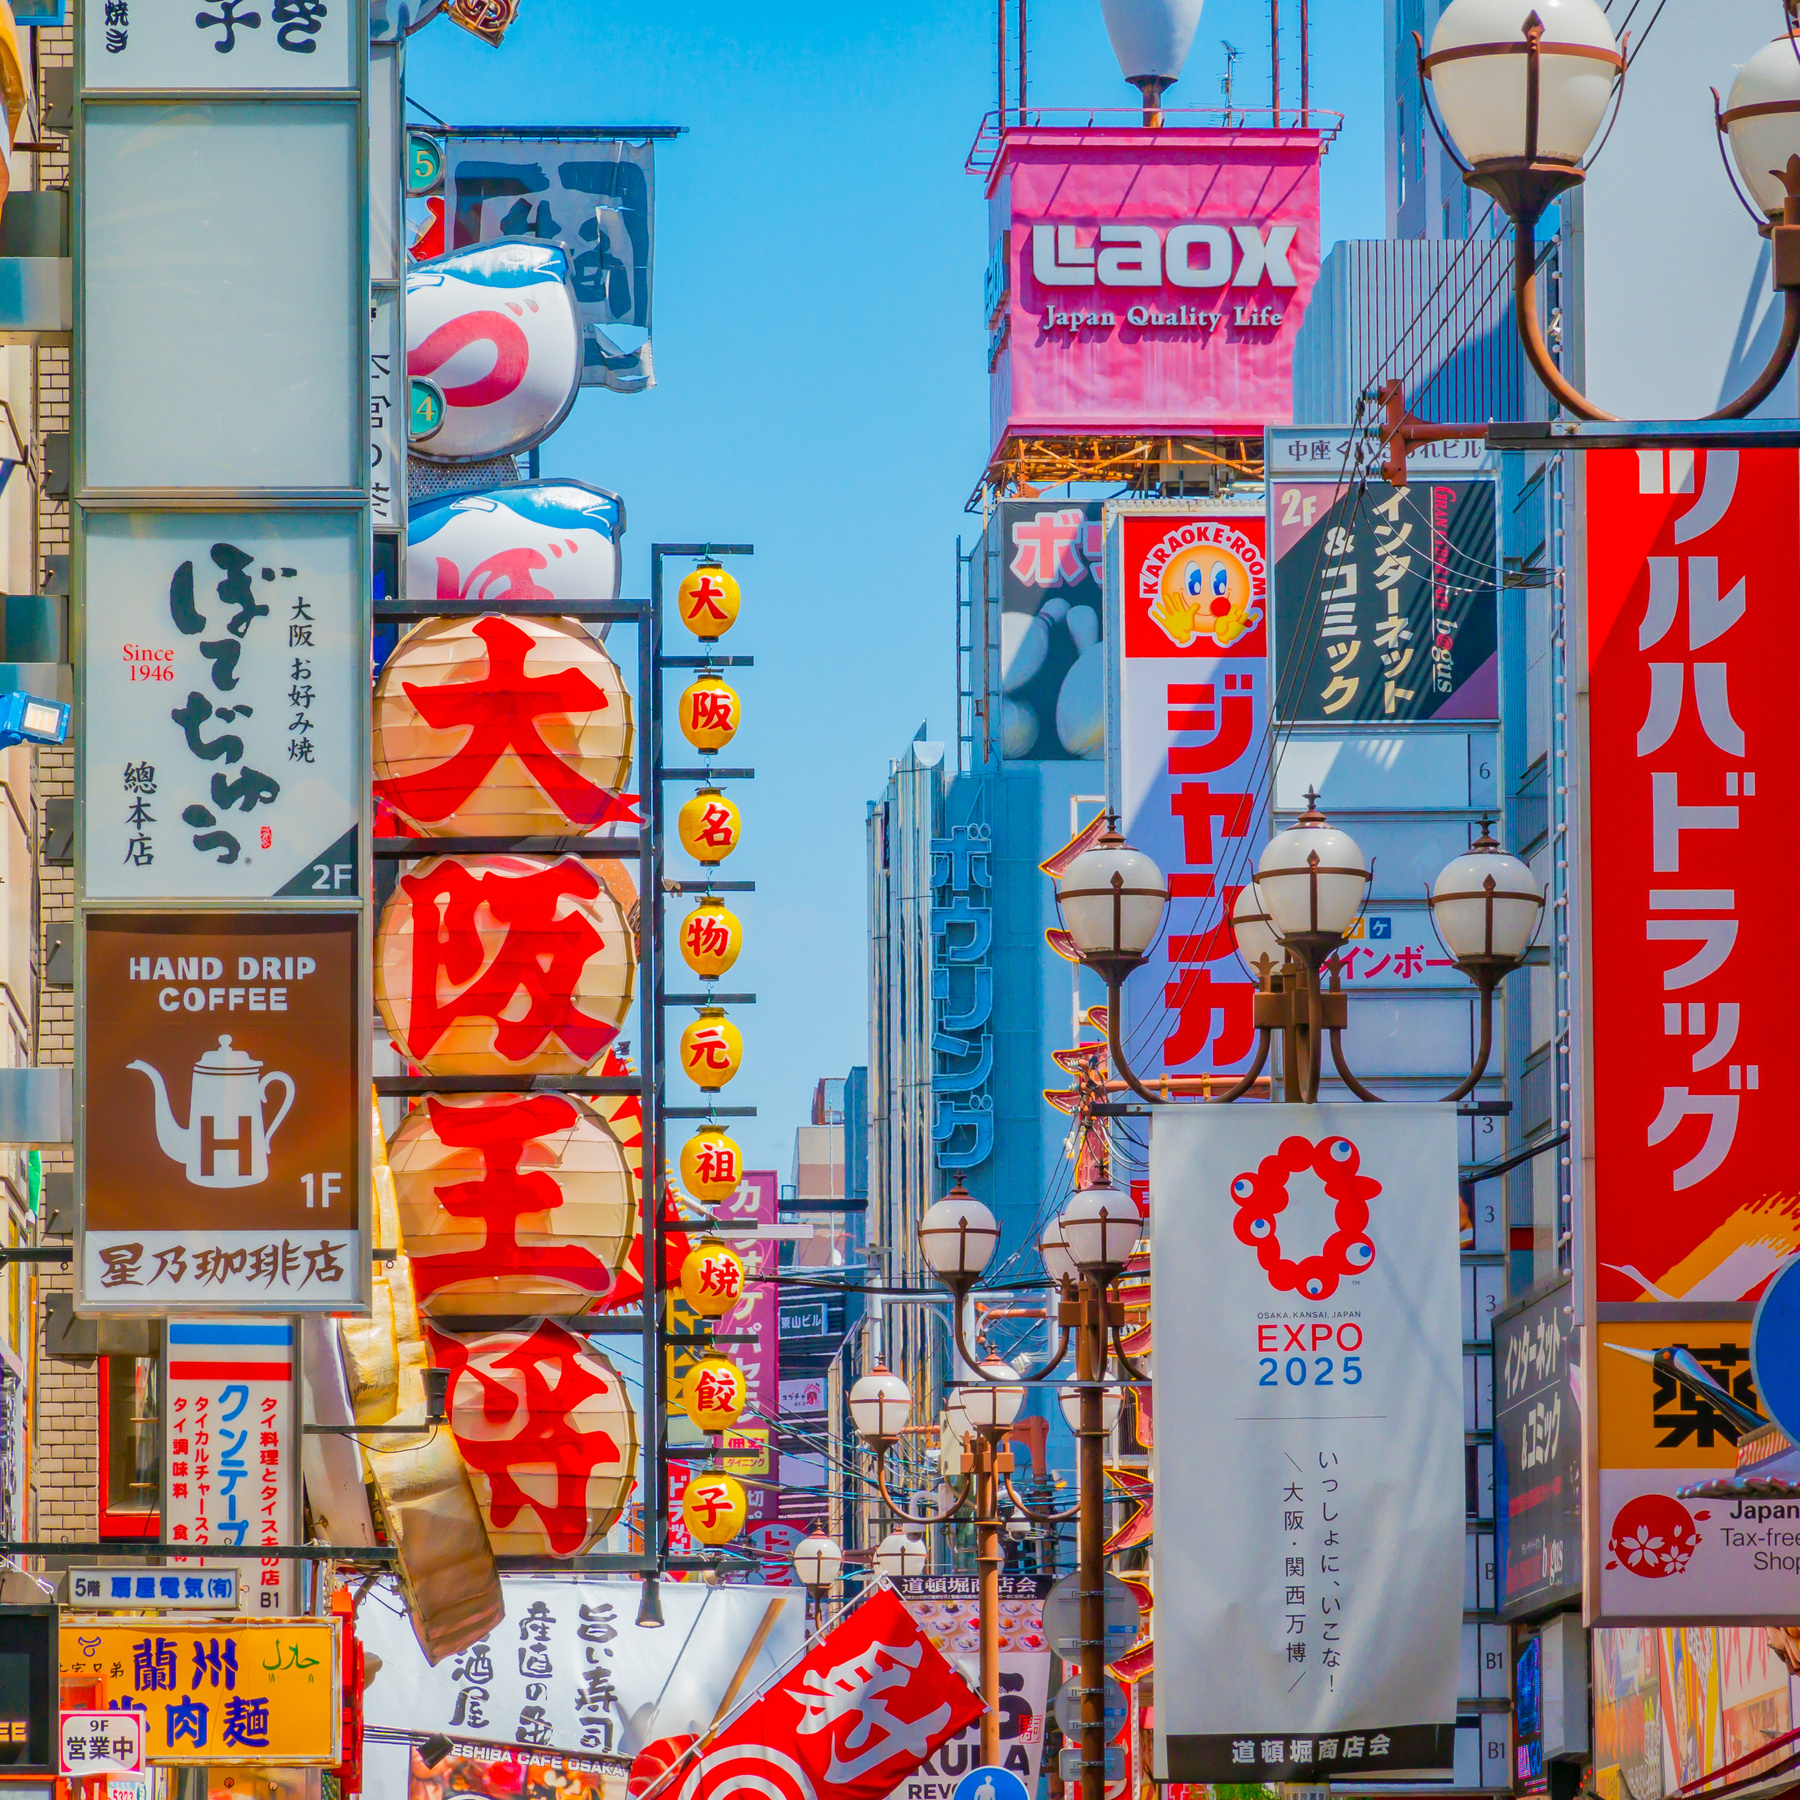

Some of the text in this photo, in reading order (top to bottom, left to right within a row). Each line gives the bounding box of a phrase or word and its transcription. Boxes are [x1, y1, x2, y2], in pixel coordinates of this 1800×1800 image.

[415, 151, 434, 178] 5
[1043, 305, 1283, 332] Japan Quality Life
[417, 396, 436, 422] 4
[1281, 488, 1317, 527] 2F
[1372, 485, 1415, 715] インターネット
[122, 643, 175, 662] Since
[129, 664, 175, 682] 1946
[169, 542, 298, 865] ぼてぢゅう
[1478, 761, 1491, 780] 6
[311, 862, 353, 890] 2F
[1163, 673, 1254, 1097] ジャンカ
[129, 956, 317, 981] HAND DRIP
[158, 986, 289, 1012] COFFEE
[930, 822, 995, 1169] ボウリング
[200, 1115, 252, 1177] H
[299, 1172, 342, 1208] 1F
[1484, 1206, 1496, 1223] 3
[98, 1238, 349, 1292] 星乃珈琲店
[1257, 1310, 1362, 1320] OSAKA, KANSAI, JAPAN
[1485, 1295, 1497, 1312] 3
[1257, 1322, 1363, 1353] EXPO
[1504, 1306, 1561, 1400] インターネット
[1258, 1356, 1363, 1386] 2025
[172, 1396, 189, 1500] タイ調味料
[217, 1384, 250, 1546] クンテープ
[259, 1591, 280, 1609] B1
[132, 1637, 239, 1692] 蘭州
[1486, 1653, 1503, 1670] B1
[448, 1634, 495, 1730] 酒屋
[89, 1719, 110, 1733] 9F
[66, 1736, 134, 1762] 営業中
[449, 1743, 625, 1777] ESHIBA CAFE OSAKA
[1231, 1733, 1392, 1765] 道頓堀商店会
[1487, 1742, 1506, 1759] B1
